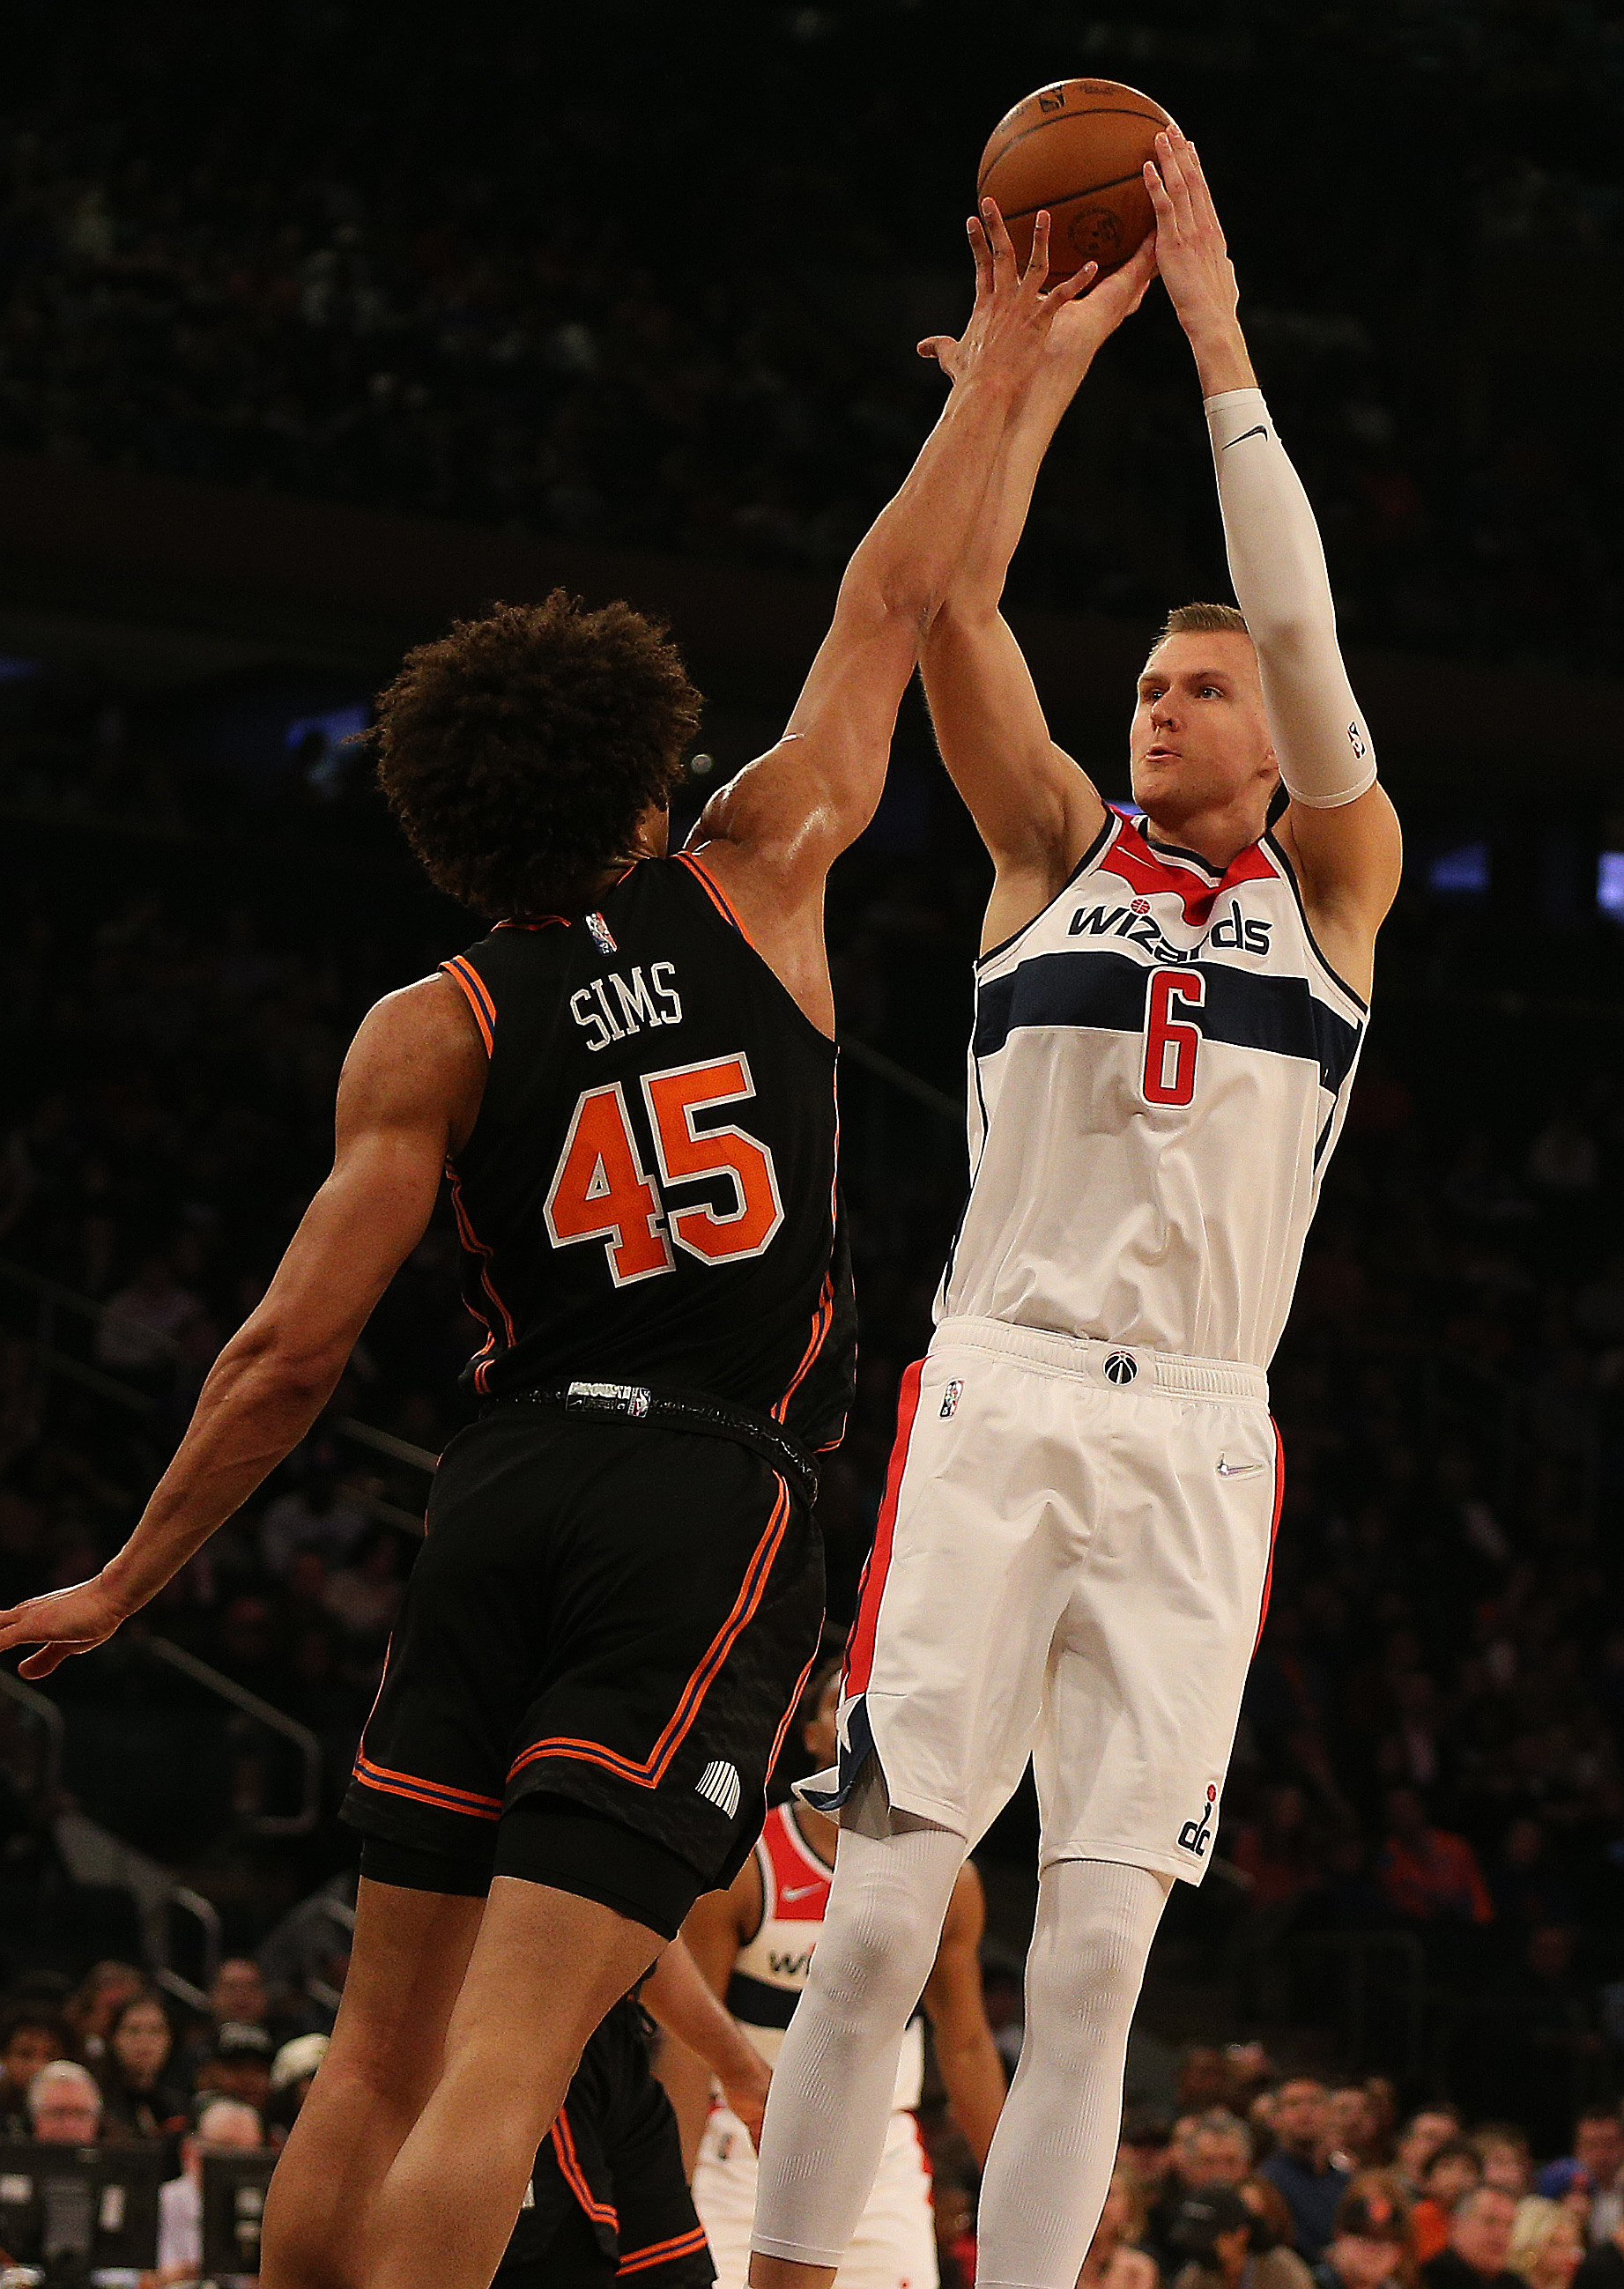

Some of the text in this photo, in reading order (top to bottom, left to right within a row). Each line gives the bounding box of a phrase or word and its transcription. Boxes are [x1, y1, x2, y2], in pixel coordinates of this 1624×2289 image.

[569, 961, 683, 1051] SIMS
[1143, 967, 1205, 1109] 6
[543, 1051, 785, 1288] 45
